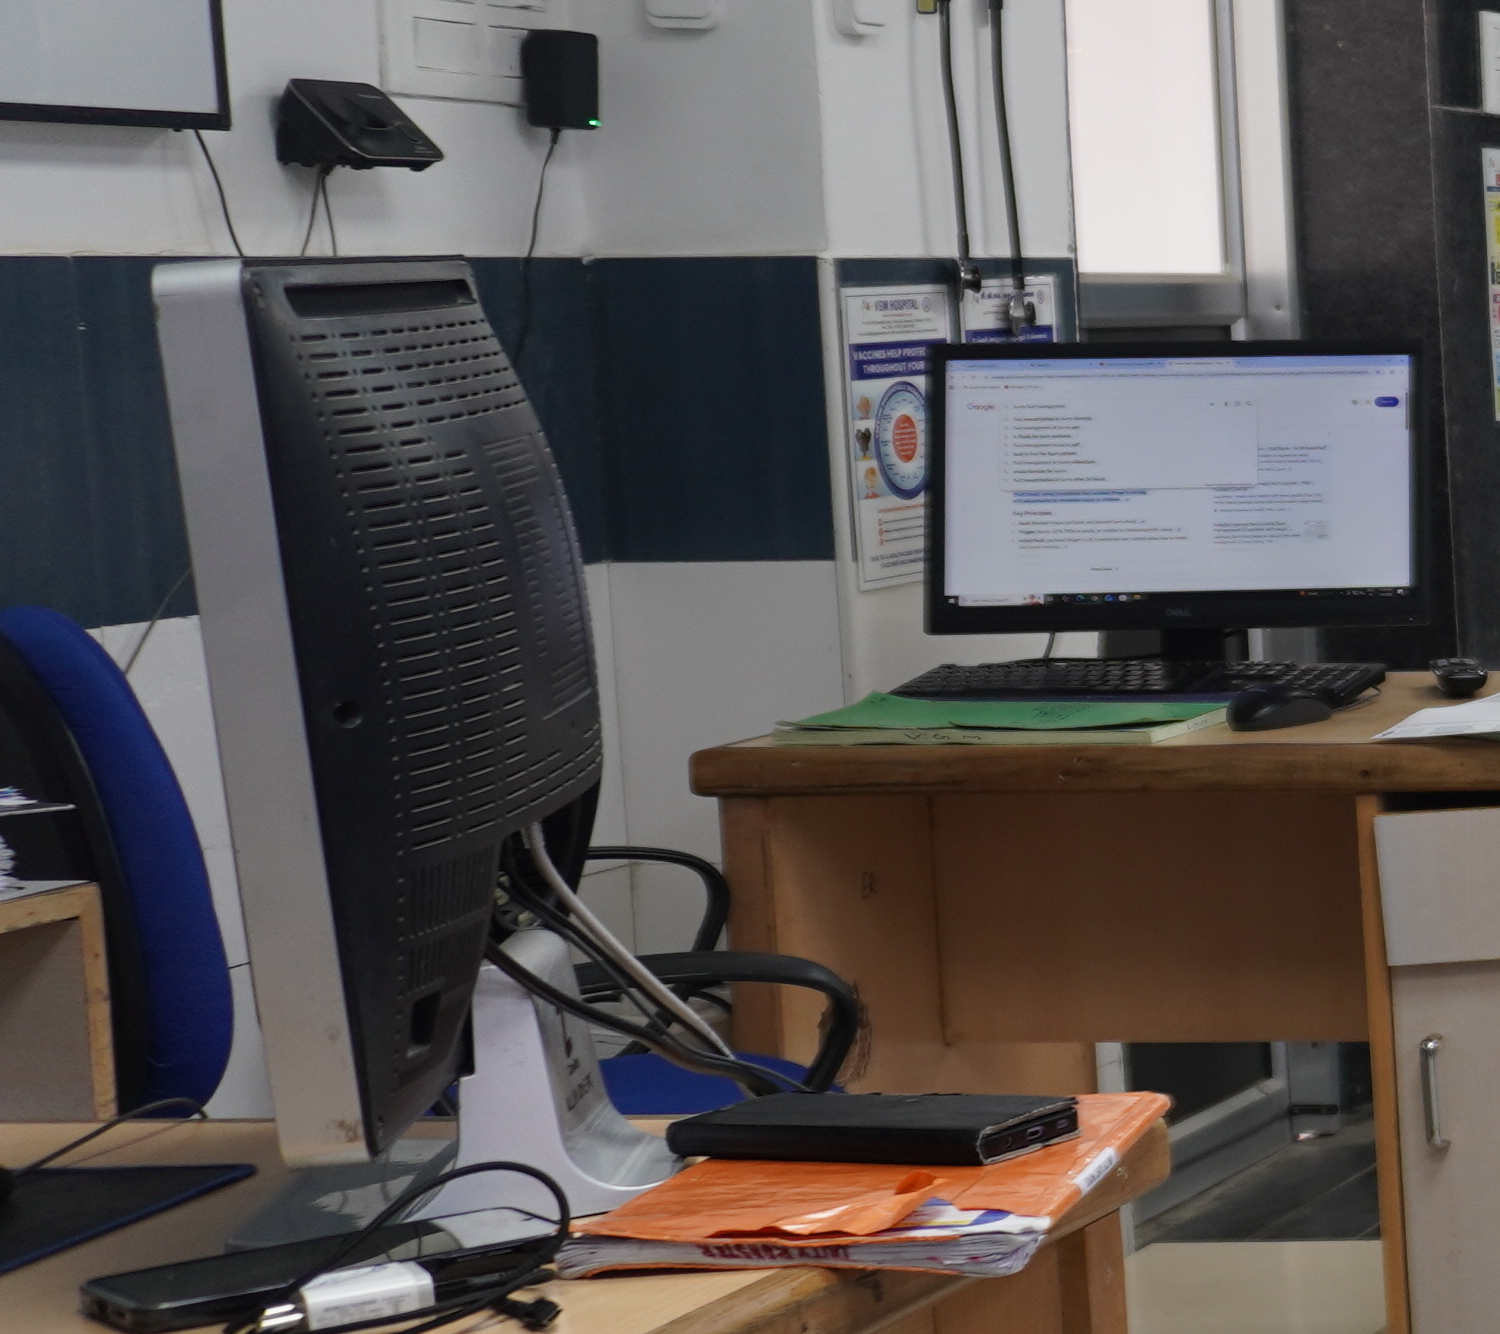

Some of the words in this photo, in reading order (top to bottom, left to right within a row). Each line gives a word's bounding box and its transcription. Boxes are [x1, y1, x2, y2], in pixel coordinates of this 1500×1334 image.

[889, 298, 919, 311] HOSPITAL
[853, 349, 887, 361] VACCINES
[887, 348, 902, 359] HELP
[863, 362, 908, 374] THROUGHOUT
[966, 402, 996, 411] Google
